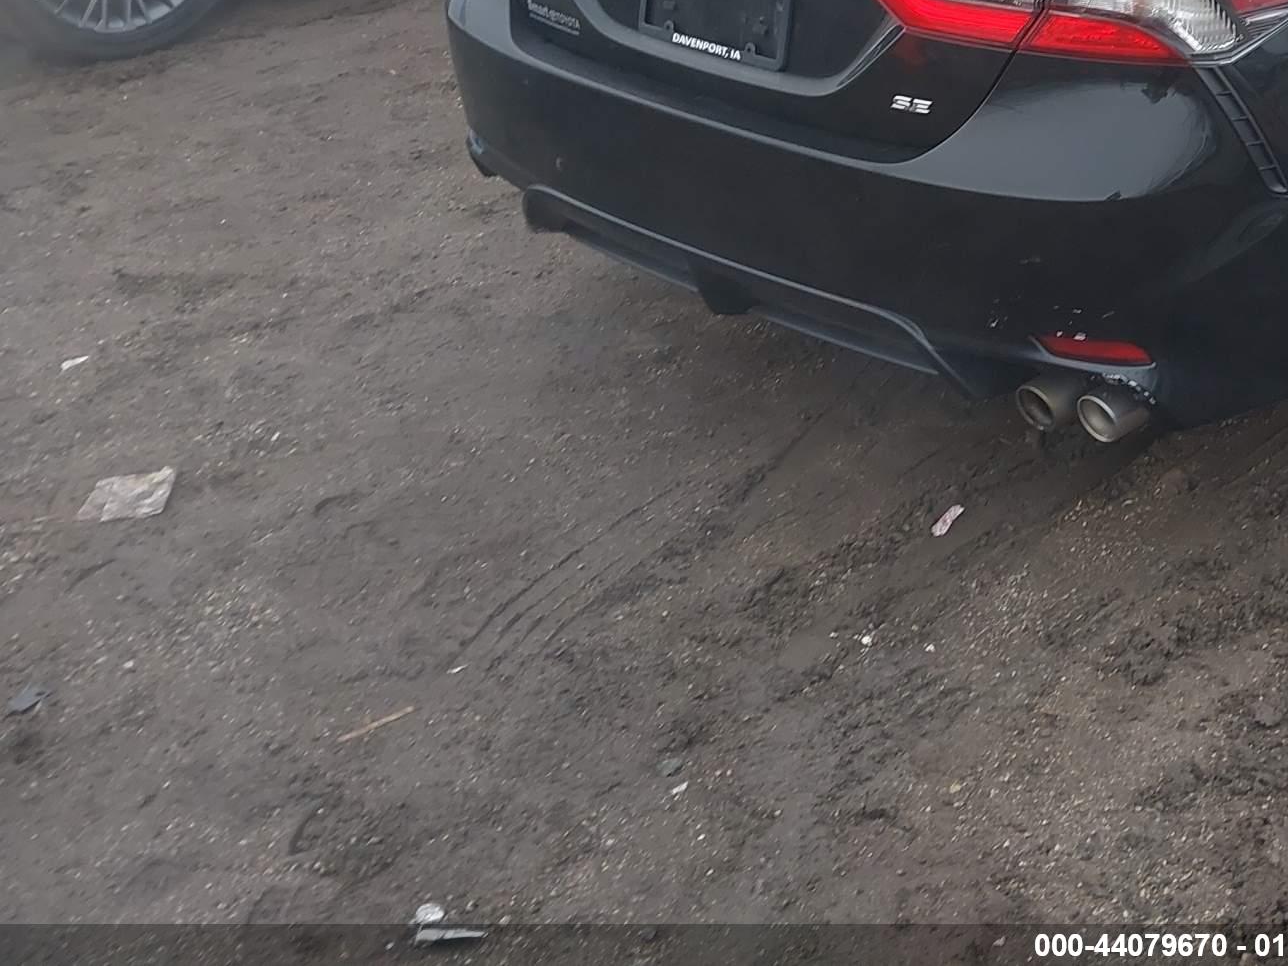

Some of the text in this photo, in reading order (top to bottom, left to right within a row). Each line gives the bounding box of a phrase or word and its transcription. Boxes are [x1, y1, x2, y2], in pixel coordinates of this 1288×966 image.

[672, 32, 741, 61] DAVENPORT, IA
[890, 95, 933, 114] SE
